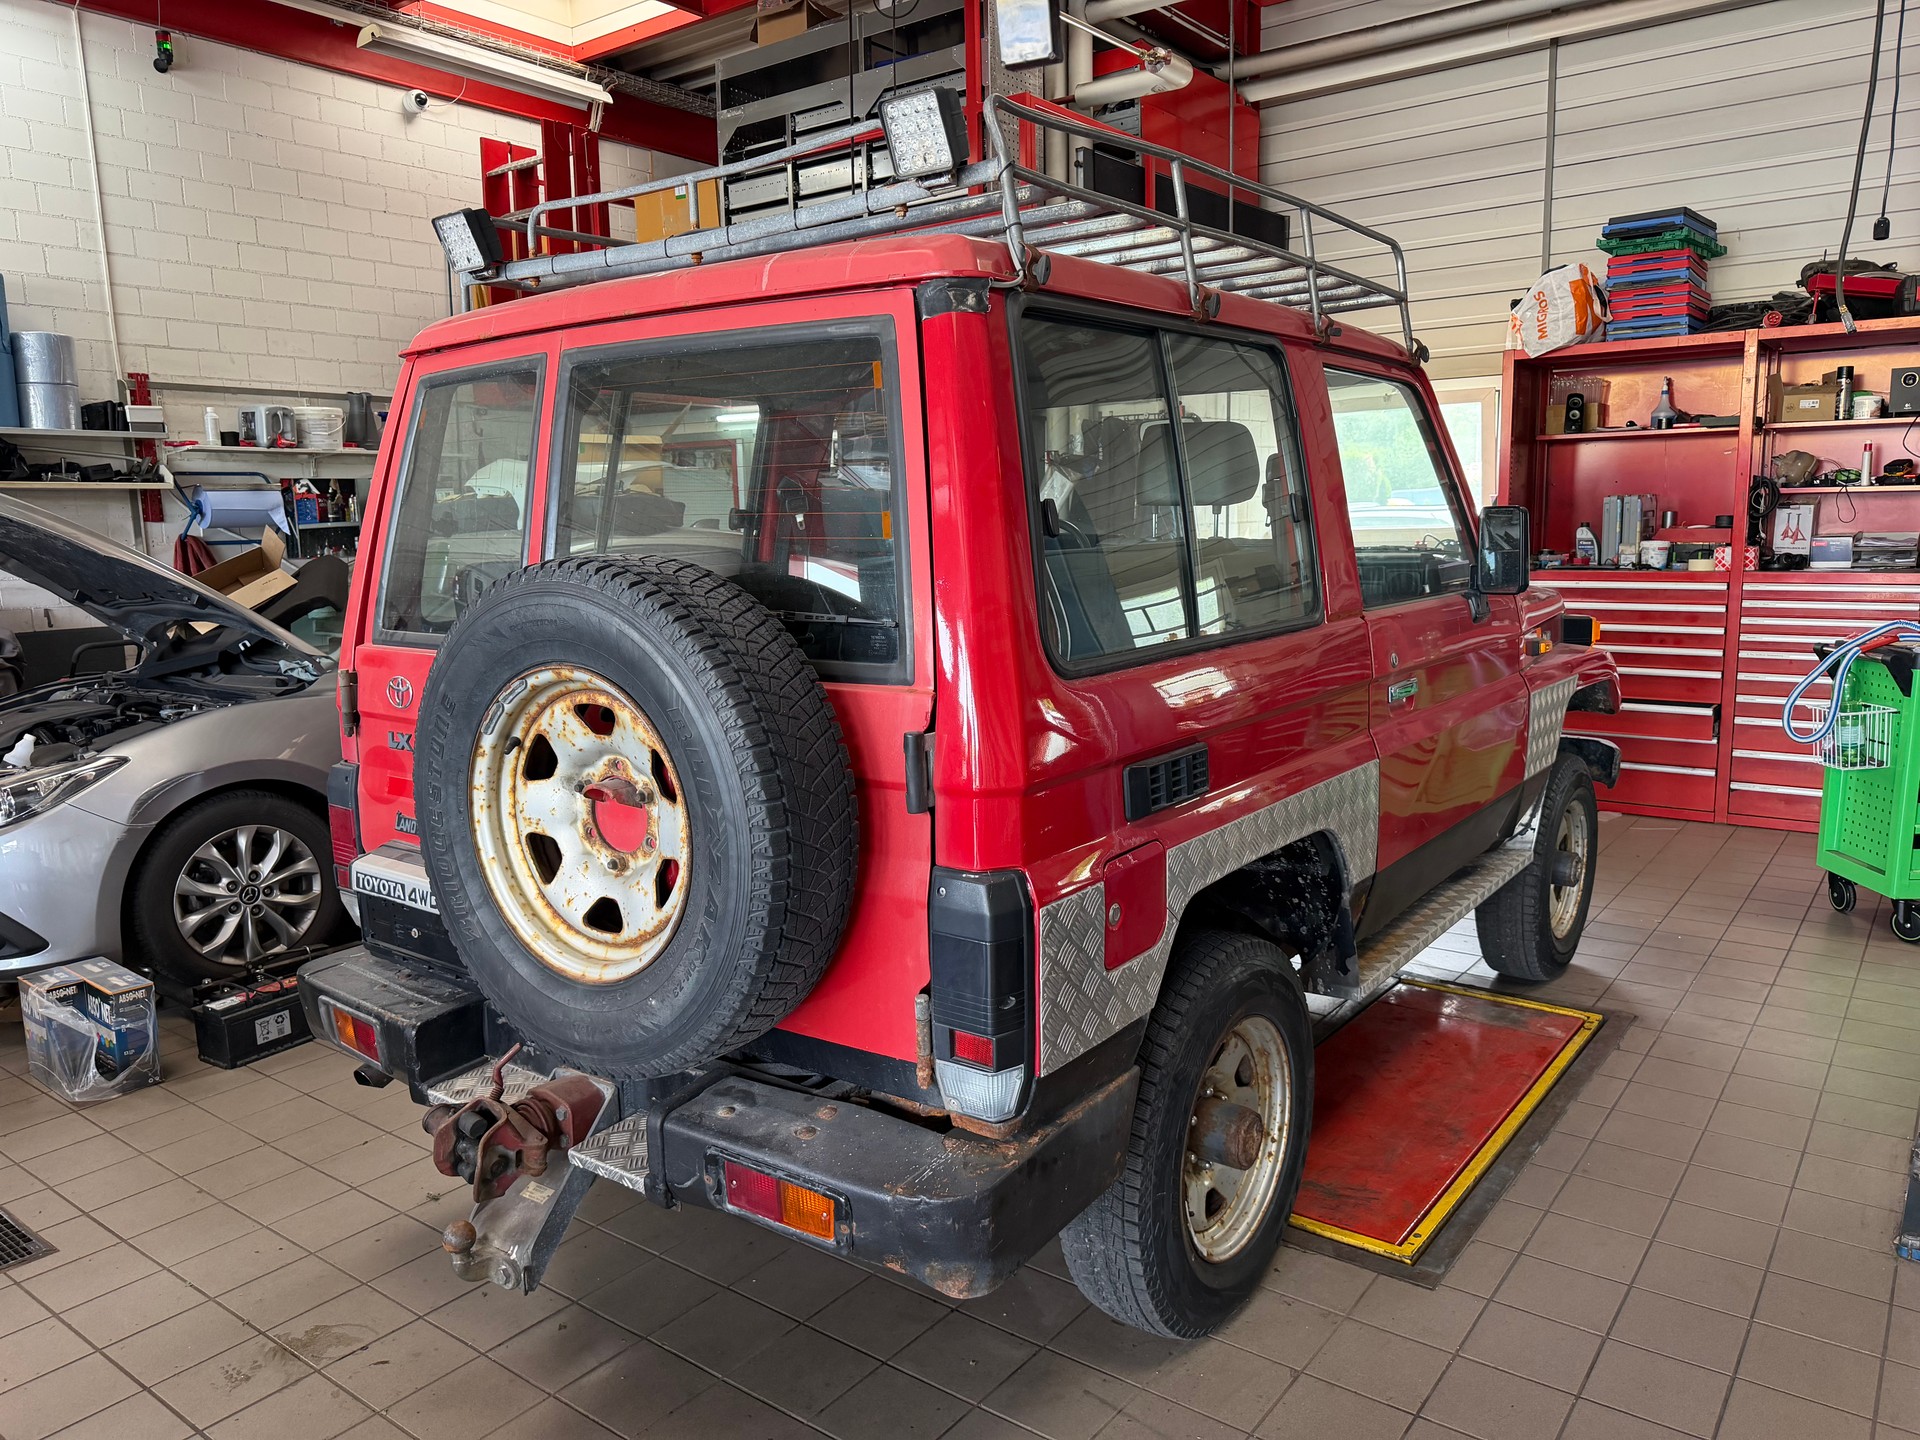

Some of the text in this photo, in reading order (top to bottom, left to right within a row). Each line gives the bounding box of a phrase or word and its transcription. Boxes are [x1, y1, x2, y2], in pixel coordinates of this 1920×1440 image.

[1533, 290, 1549, 341] MIGROS
[388, 730, 414, 752] LX
[395, 811, 418, 834] LAND
[357, 872, 406, 902] TOYOTA
